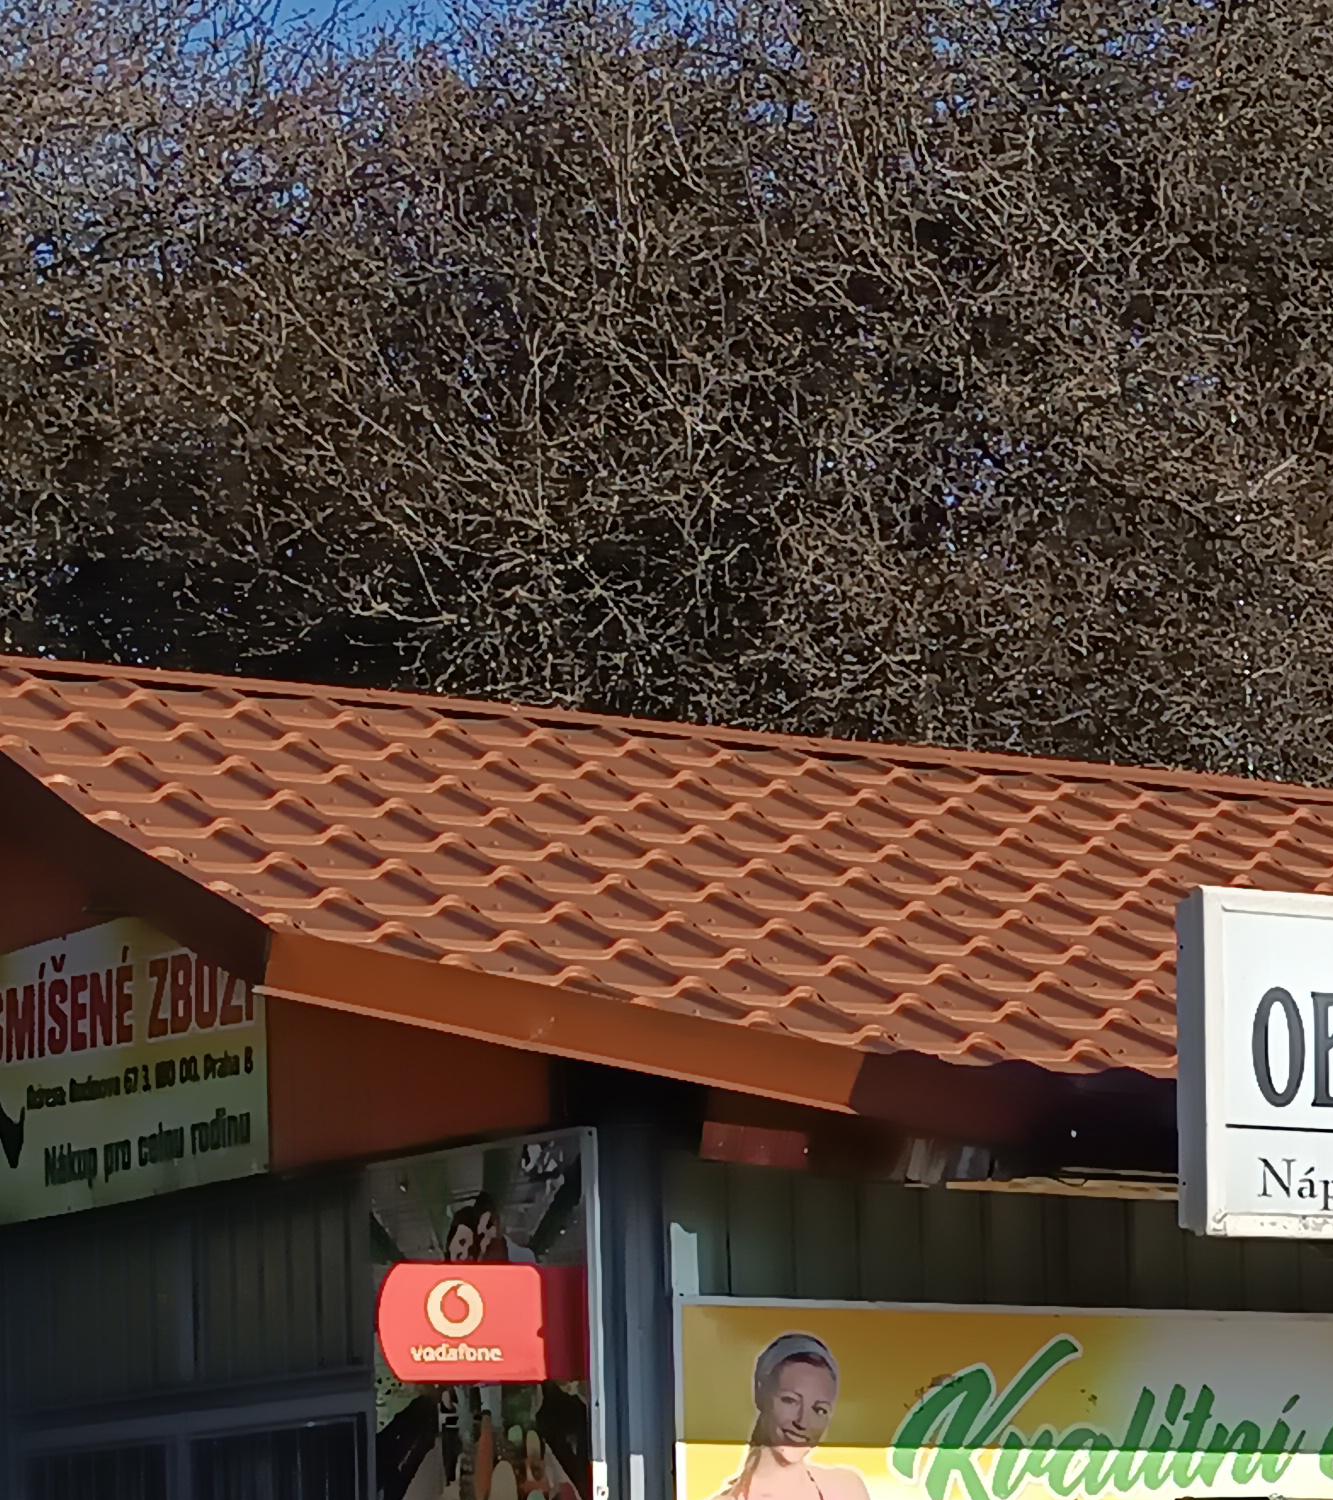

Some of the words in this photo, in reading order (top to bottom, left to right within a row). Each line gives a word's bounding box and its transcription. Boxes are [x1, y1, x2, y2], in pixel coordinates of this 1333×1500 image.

[0, 945, 134, 1063] MÍŠENÉ
[203, 1050, 240, 1080] Praha
[103, 1138, 131, 1183] pro
[191, 1107, 251, 1155] rodinu
[410, 1344, 504, 1363] vodafone
